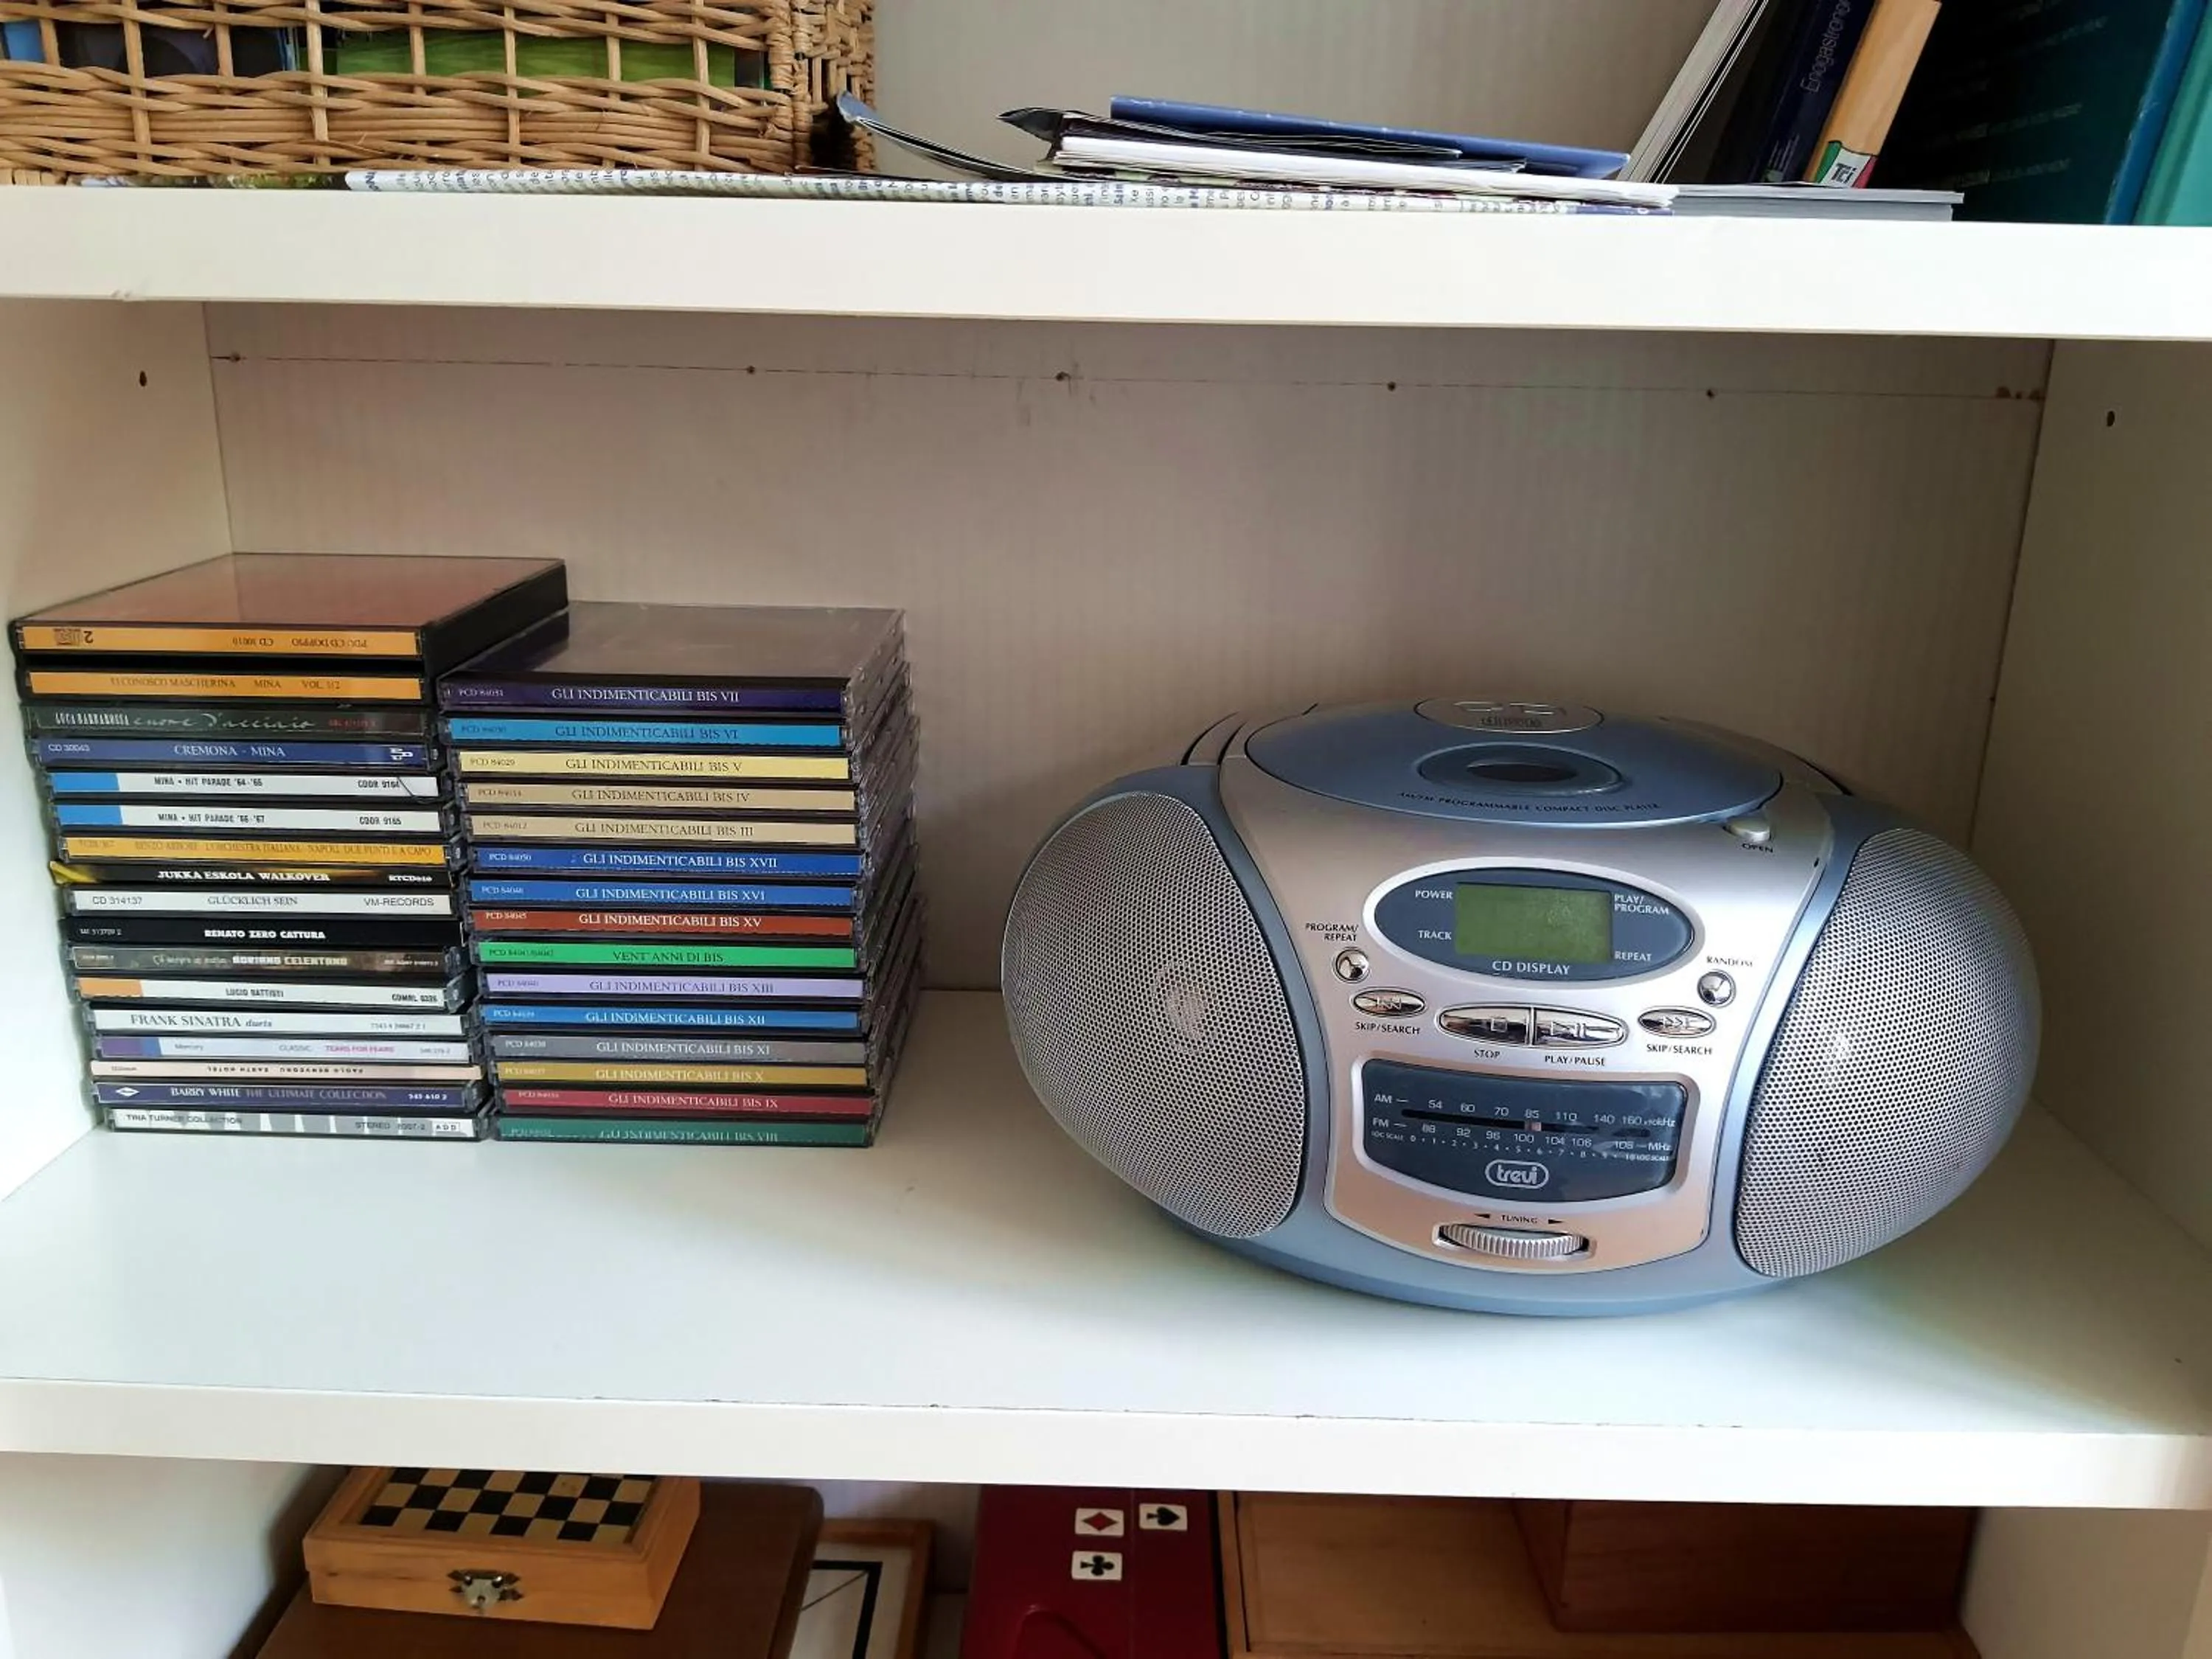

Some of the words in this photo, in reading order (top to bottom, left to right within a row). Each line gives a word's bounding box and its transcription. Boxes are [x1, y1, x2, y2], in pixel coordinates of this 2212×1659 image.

[84, 630, 94, 644] 2
[254, 680, 282, 689] MINA
[552, 688, 574, 700] GLI
[578, 689, 693, 701] INDIMENTICABILI
[696, 691, 717, 701] BIS
[720, 692, 739, 702] VII
[555, 726, 577, 737] GLI
[581, 726, 694, 738] INDIMENTICABILI
[700, 728, 720, 739] BIS
[721, 729, 738, 739] VI
[174, 745, 237, 757] CREMONA
[251, 746, 286, 757] MINA
[566, 759, 587, 769] GLI
[591, 759, 703, 771] INDIMENTICABILI
[708, 761, 729, 772] BIS
[734, 761, 742, 772] V
[154, 777, 175, 785] MINA
[185, 778, 199, 786] HIT
[202, 778, 231, 787] PARADE
[571, 789, 593, 800] GLI
[598, 790, 709, 801] INDIMENTICABILI
[713, 791, 734, 802] BIS
[737, 792, 751, 802] IV
[157, 813, 178, 821] MINA
[188, 813, 201, 822] HIT
[204, 814, 234, 823] PARADE
[575, 823, 595, 833] GLI
[600, 824, 712, 835] INDIMENTICABILI
[717, 826, 737, 836] BIS
[740, 827, 754, 837] III
[1742, 843, 1774, 853] OPEN
[583, 853, 605, 864] GLI
[609, 855, 721, 866] INDIMENTICABILI
[726, 856, 746, 866] BIS
[750, 858, 777, 868] XVII
[157, 870, 202, 880] JUKKA
[205, 871, 255, 880] ESKOLA
[258, 872, 330, 882] WALKOVER
[576, 888, 597, 898] GLI
[602, 888, 714, 900] INDIMENTICABILI
[719, 890, 738, 900] BIS
[742, 891, 765, 901] XVI
[1415, 889, 1453, 900] POWER
[1614, 894, 1645, 905] PLAY/
[92, 896, 107, 905] CD
[274, 896, 298, 905] SEIN
[364, 897, 434, 906] VM-RECORDS
[1614, 903, 1669, 916] PROGRAM
[579, 914, 600, 924] GLI
[605, 914, 715, 927] INDIMENTICABILI
[720, 917, 740, 927] BIS
[742, 917, 762, 928] XV
[1305, 922, 1358, 933] PROGRAM/
[204, 930, 246, 939] RENATO
[249, 931, 276, 939] ZERO
[280, 931, 326, 939] CATTURA
[1324, 933, 1357, 942] REPEAT
[1418, 930, 1452, 941] TRACK
[704, 952, 724, 962] BIS
[1614, 951, 1652, 962] REPEAT
[1492, 961, 1512, 972] CD
[1517, 962, 1571, 975] DISPLAY
[225, 988, 248, 997] LUCIO
[250, 989, 284, 998] BATTISTI
[589, 981, 612, 991] GLI
[615, 981, 727, 992] INDIMENTICABILI
[729, 983, 748, 993] BIS
[751, 984, 773, 994] XIII
[131, 1014, 178, 1026] FRANK
[181, 1015, 241, 1027] SINATRA
[586, 1012, 608, 1022] GLI
[611, 1012, 722, 1023] INDIMENTICABILI
[725, 1014, 745, 1024] BIS
[748, 1015, 765, 1025] XII
[1355, 1021, 1420, 1034] SKIP/SEARCH
[597, 1042, 618, 1052] GLI
[622, 1043, 731, 1054] INDIMENTICABILI
[734, 1045, 754, 1055] BIS
[757, 1045, 771, 1056] XI
[1474, 1049, 1501, 1060] STOP
[1646, 1043, 1713, 1056] SKIP/SEARCH
[1544, 1055, 1606, 1067] PLAY/PAUSE
[596, 1070, 618, 1079] GLI
[619, 1070, 731, 1081] INDIMENTICABILI
[734, 1071, 752, 1081] BIS
[755, 1072, 764, 1082] X
[170, 1087, 205, 1097] BARRY
[209, 1087, 241, 1098] WHITE
[319, 1090, 386, 1099] COLLECTION
[608, 1094, 629, 1104] GLI
[633, 1095, 738, 1107] INDIMENTICABILI
[742, 1098, 762, 1107] BIS
[766, 1099, 778, 1108] IX
[1374, 1093, 1393, 1104] AM
[1428, 1099, 1443, 1110] 54
[1461, 1103, 1475, 1113] 60
[1494, 1107, 1509, 1117] 70
[1524, 1109, 1540, 1119] 85
[1556, 1111, 1578, 1122] 110
[1593, 1114, 1615, 1124] 140
[1621, 1116, 1642, 1125] 160
[1372, 1118, 1390, 1128] FM
[1422, 1123, 1436, 1134] 88
[1456, 1127, 1472, 1138] 92
[1486, 1130, 1500, 1141] 96
[1514, 1133, 1534, 1144] 100
[1545, 1136, 1565, 1146] 104
[1571, 1138, 1593, 1148] 106
[1647, 1142, 1673, 1152] MHz
[1496, 1164, 1538, 1185] trevi
[1500, 1214, 1538, 1225] TUNING
